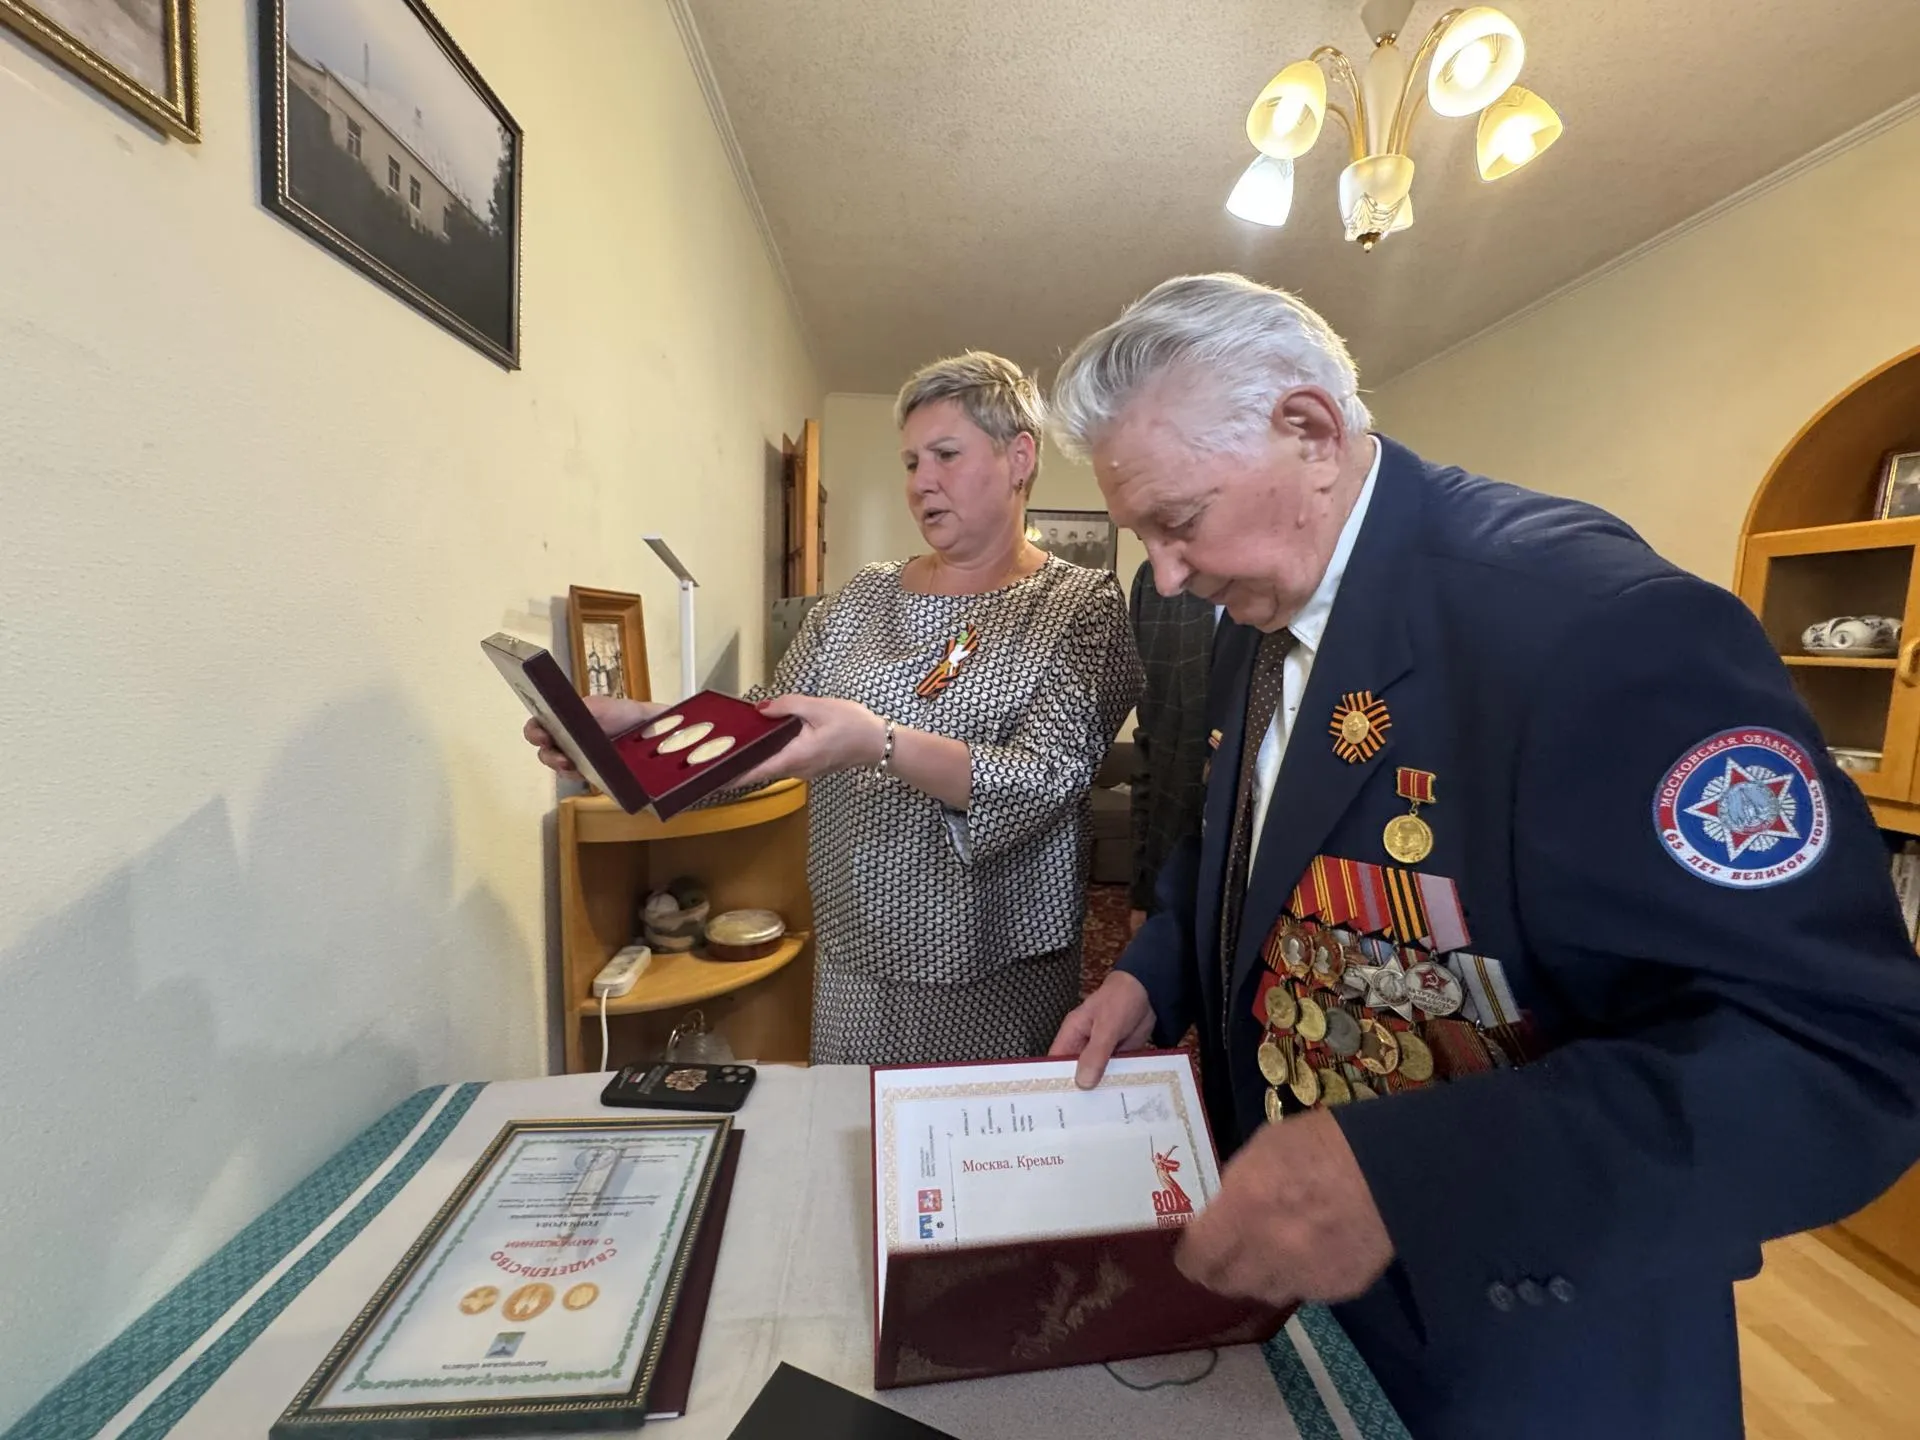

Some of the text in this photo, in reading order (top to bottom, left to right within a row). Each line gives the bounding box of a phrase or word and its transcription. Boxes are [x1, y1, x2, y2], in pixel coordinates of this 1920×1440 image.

[1659, 734, 1802, 809] МОСКОВСКАЯ ОБЛАСТЬ
[1665, 832, 1685, 850] 65
[1686, 854, 1721, 875] ЛЕТ
[1730, 853, 1807, 881] ВЕЛИКОЙ
[962, 1154, 1065, 1174] Москва. Кремль
[1151, 1189, 1178, 1213] 80
[603, 1237, 614, 1247] О
[489, 1247, 618, 1279] СВИДЕТЕЛЬСТВО
